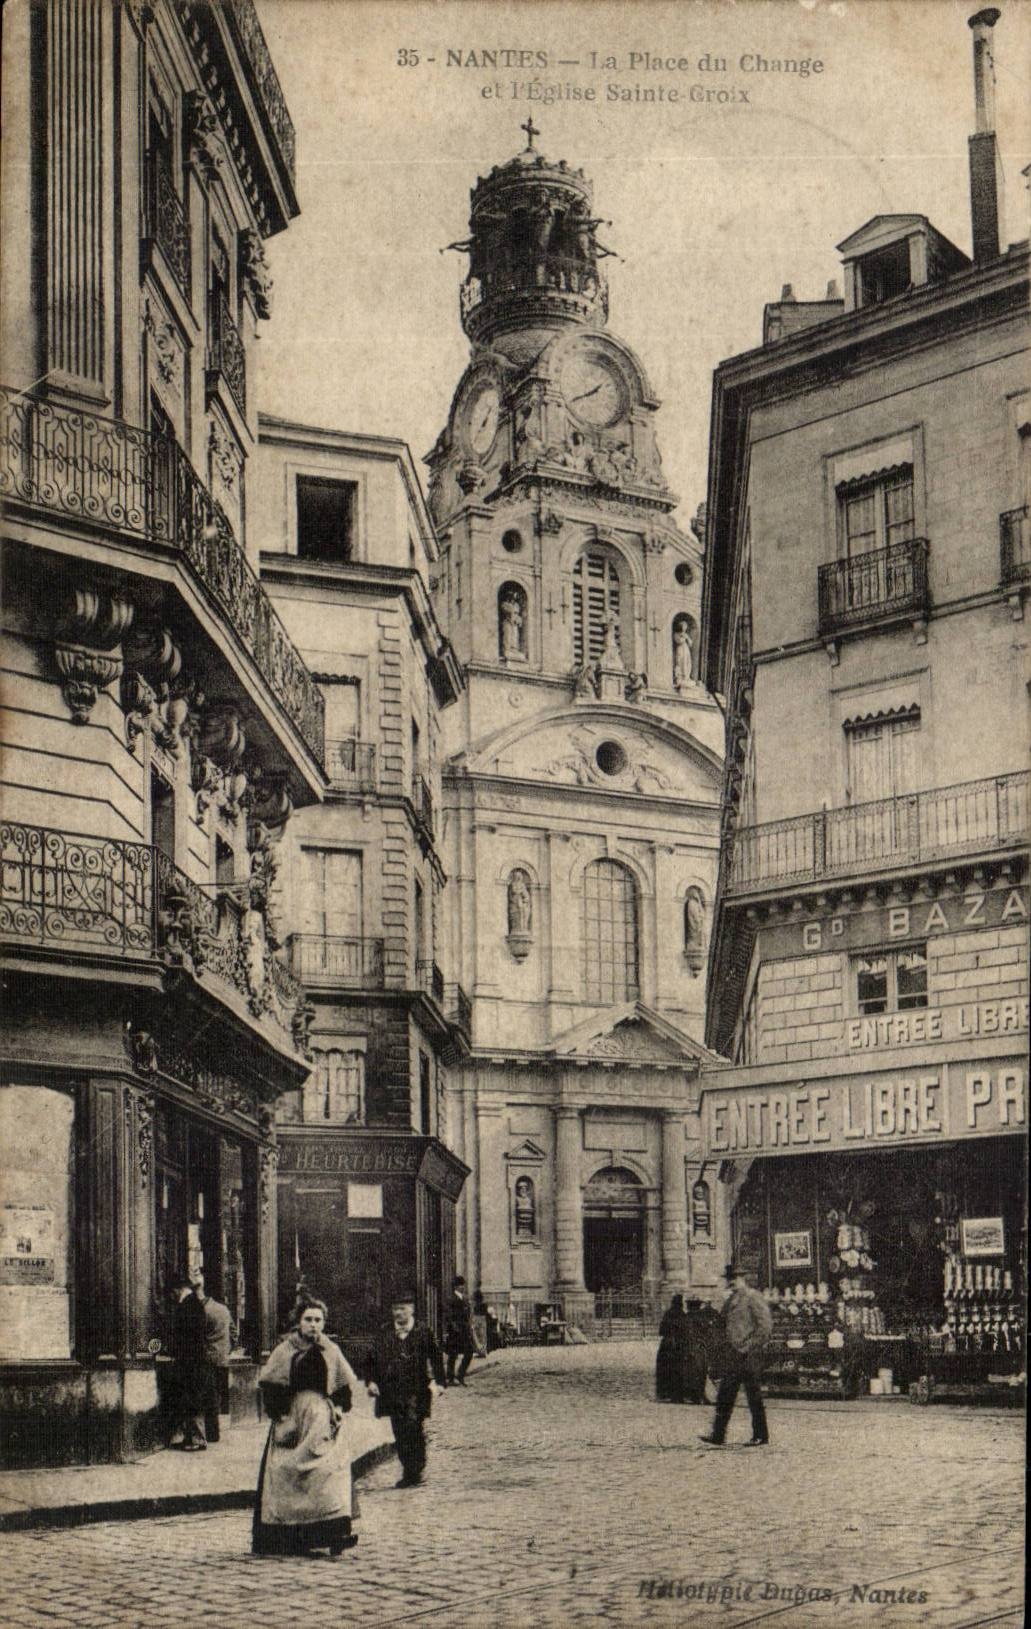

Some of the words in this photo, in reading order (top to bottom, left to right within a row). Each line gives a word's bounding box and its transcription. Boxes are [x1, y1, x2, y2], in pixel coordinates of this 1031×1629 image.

[888, 889, 1028, 937] BAZA
[710, 1081, 831, 1153] ENTRÉE
[842, 1075, 942, 1140] LIBRE
